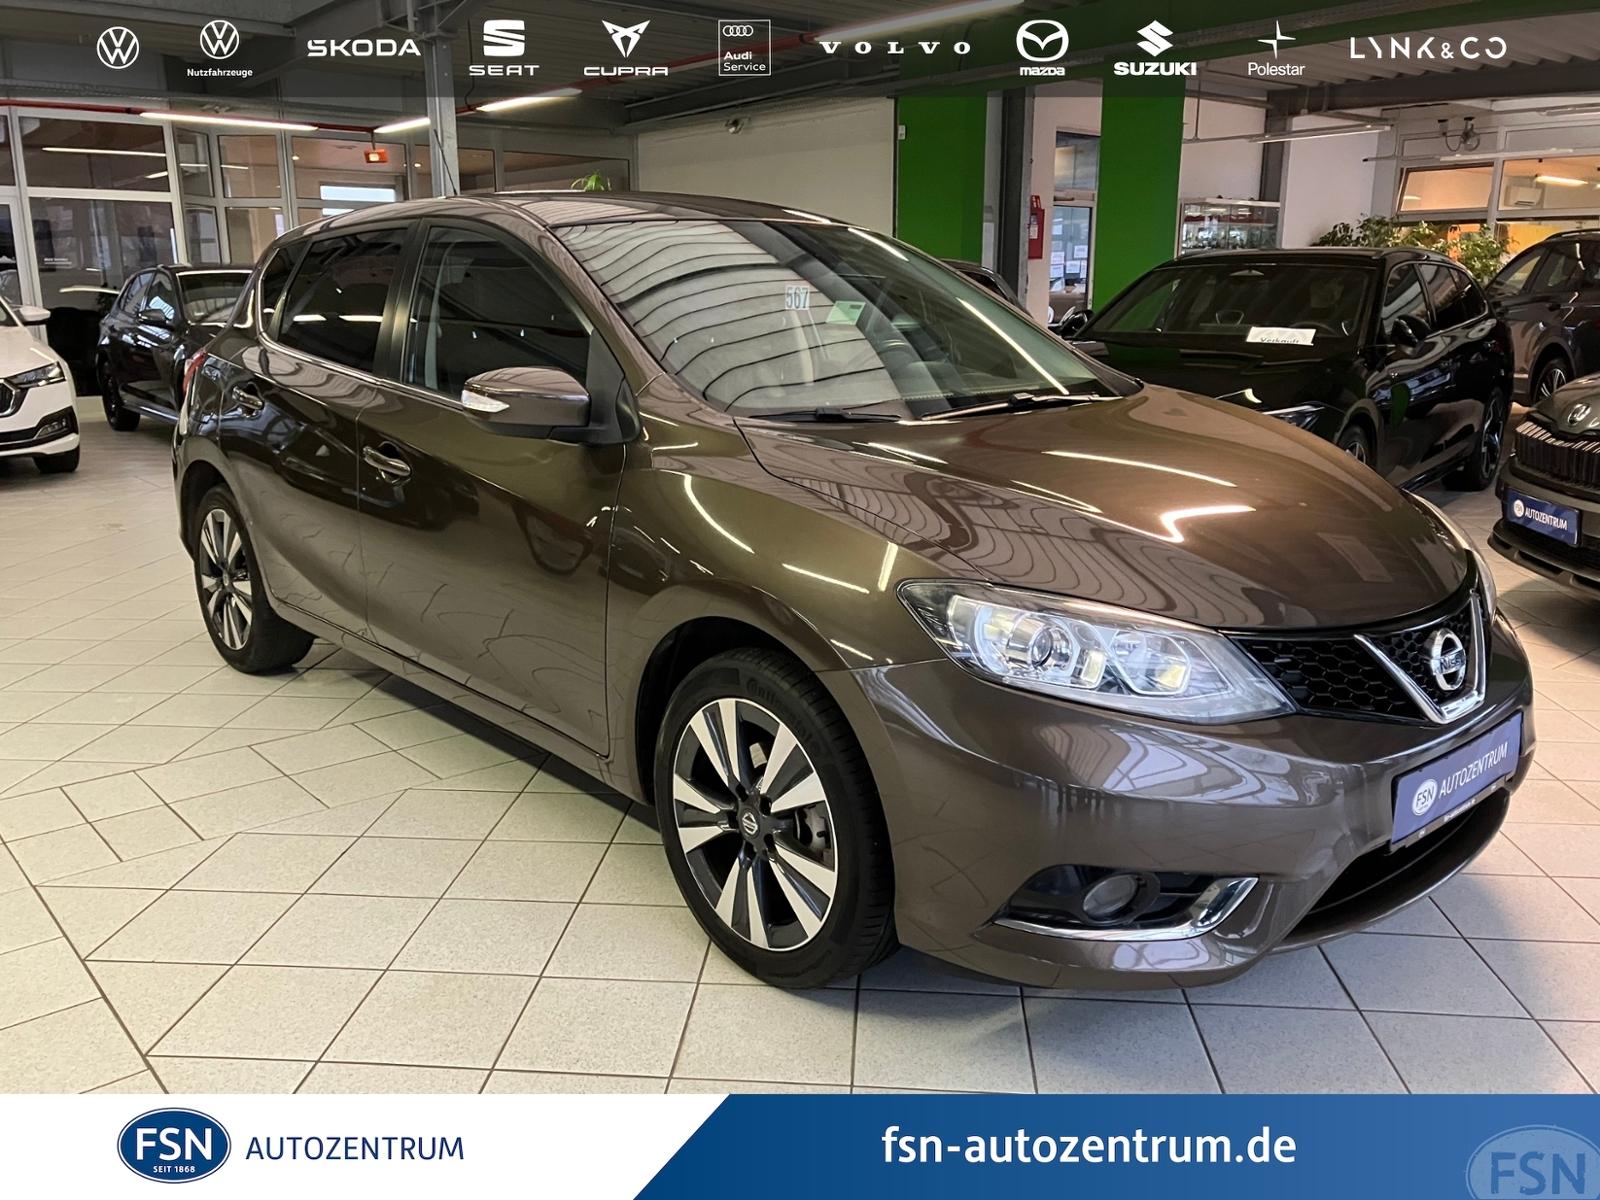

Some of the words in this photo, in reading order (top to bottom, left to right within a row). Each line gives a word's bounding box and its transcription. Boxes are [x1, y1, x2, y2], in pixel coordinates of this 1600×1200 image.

[785, 286, 809, 309] 567
[1524, 507, 1568, 531] AUTOZENTRUM
[1415, 787, 1435, 807] FSN
[1438, 741, 1508, 799] AUTOZENTRUM
